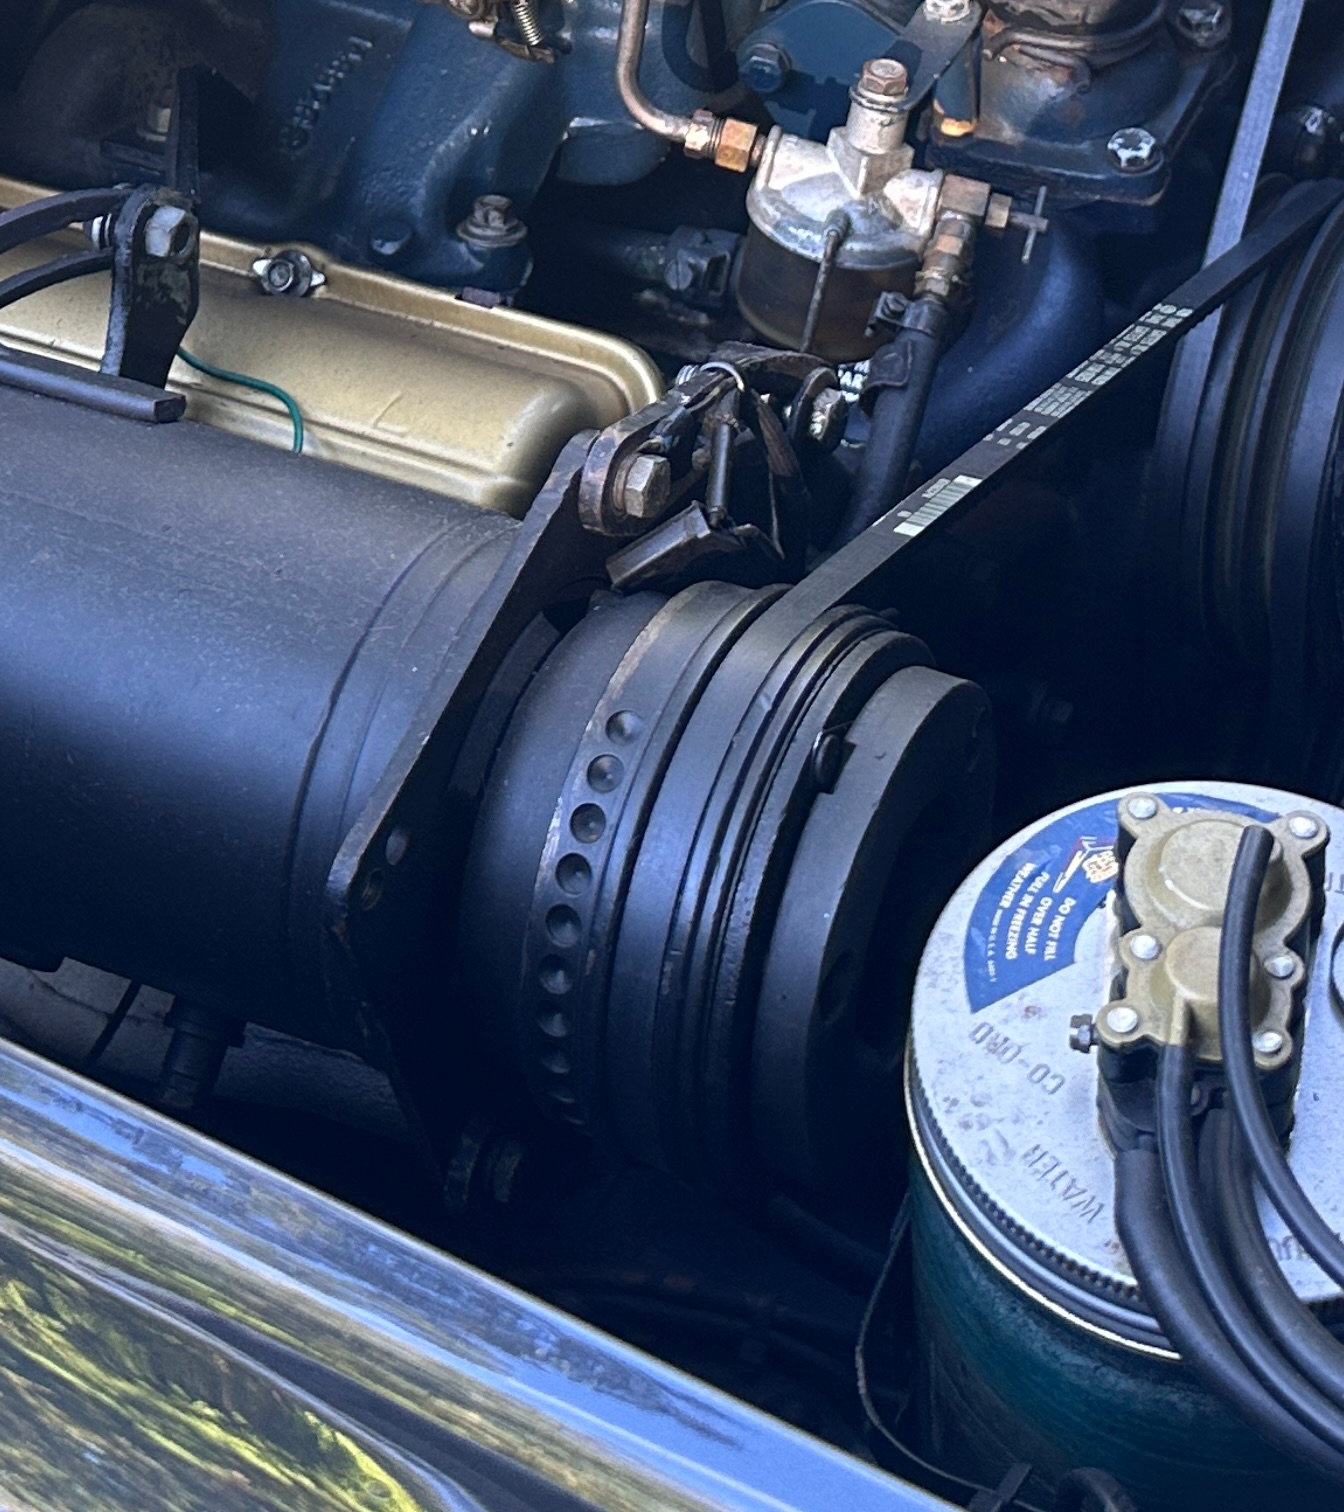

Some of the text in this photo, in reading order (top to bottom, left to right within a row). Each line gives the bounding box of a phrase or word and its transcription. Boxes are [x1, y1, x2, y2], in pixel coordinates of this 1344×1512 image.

[999, 863, 1037, 908] WEATHER
[1019, 893, 1034, 908] IN
[1005, 908, 1027, 960] FREEZING
[1024, 897, 1053, 955] OVER HALF
[1044, 897, 1076, 961] DO NOT FILL
[1018, 1142, 1108, 1224] WATER
